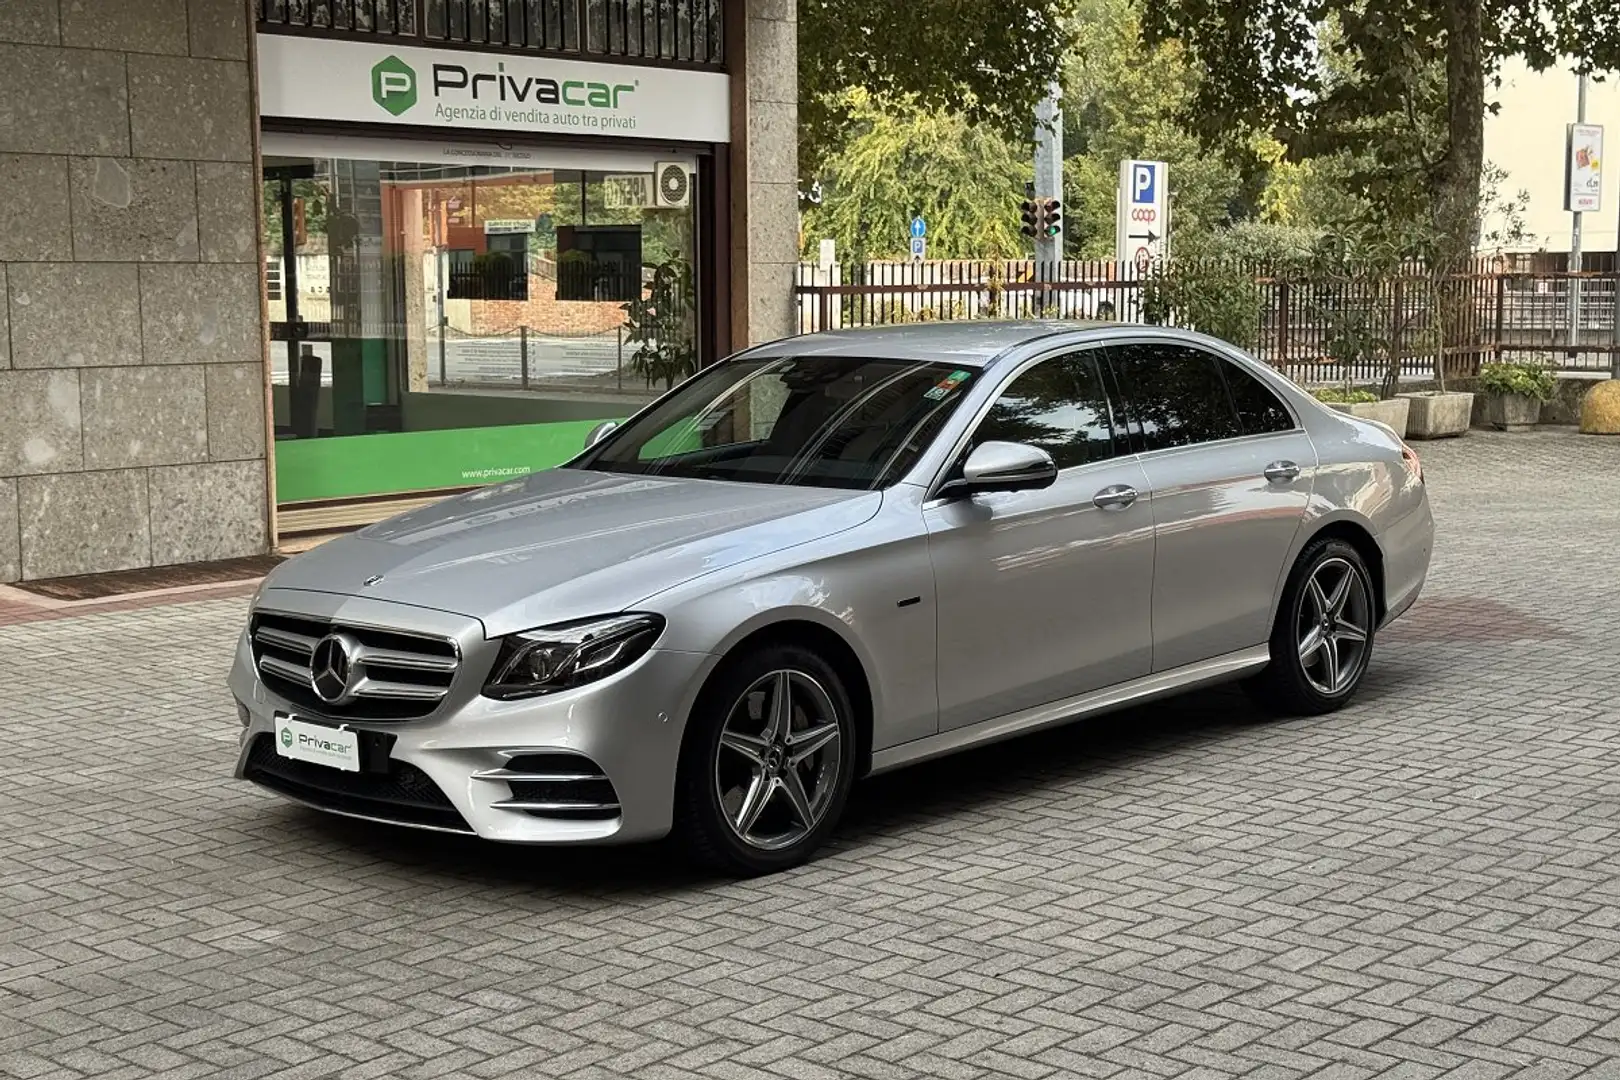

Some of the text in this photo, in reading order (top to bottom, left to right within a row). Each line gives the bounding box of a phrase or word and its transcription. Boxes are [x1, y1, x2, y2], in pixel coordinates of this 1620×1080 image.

[433, 62, 635, 108] Privacar
[435, 103, 636, 130] Agenzia di vendita auto tra privati
[1135, 167, 1151, 200] P
[1132, 208, 1156, 224] coop
[461, 466, 531, 479] www.privacar.com
[299, 733, 352, 754] Privacar
